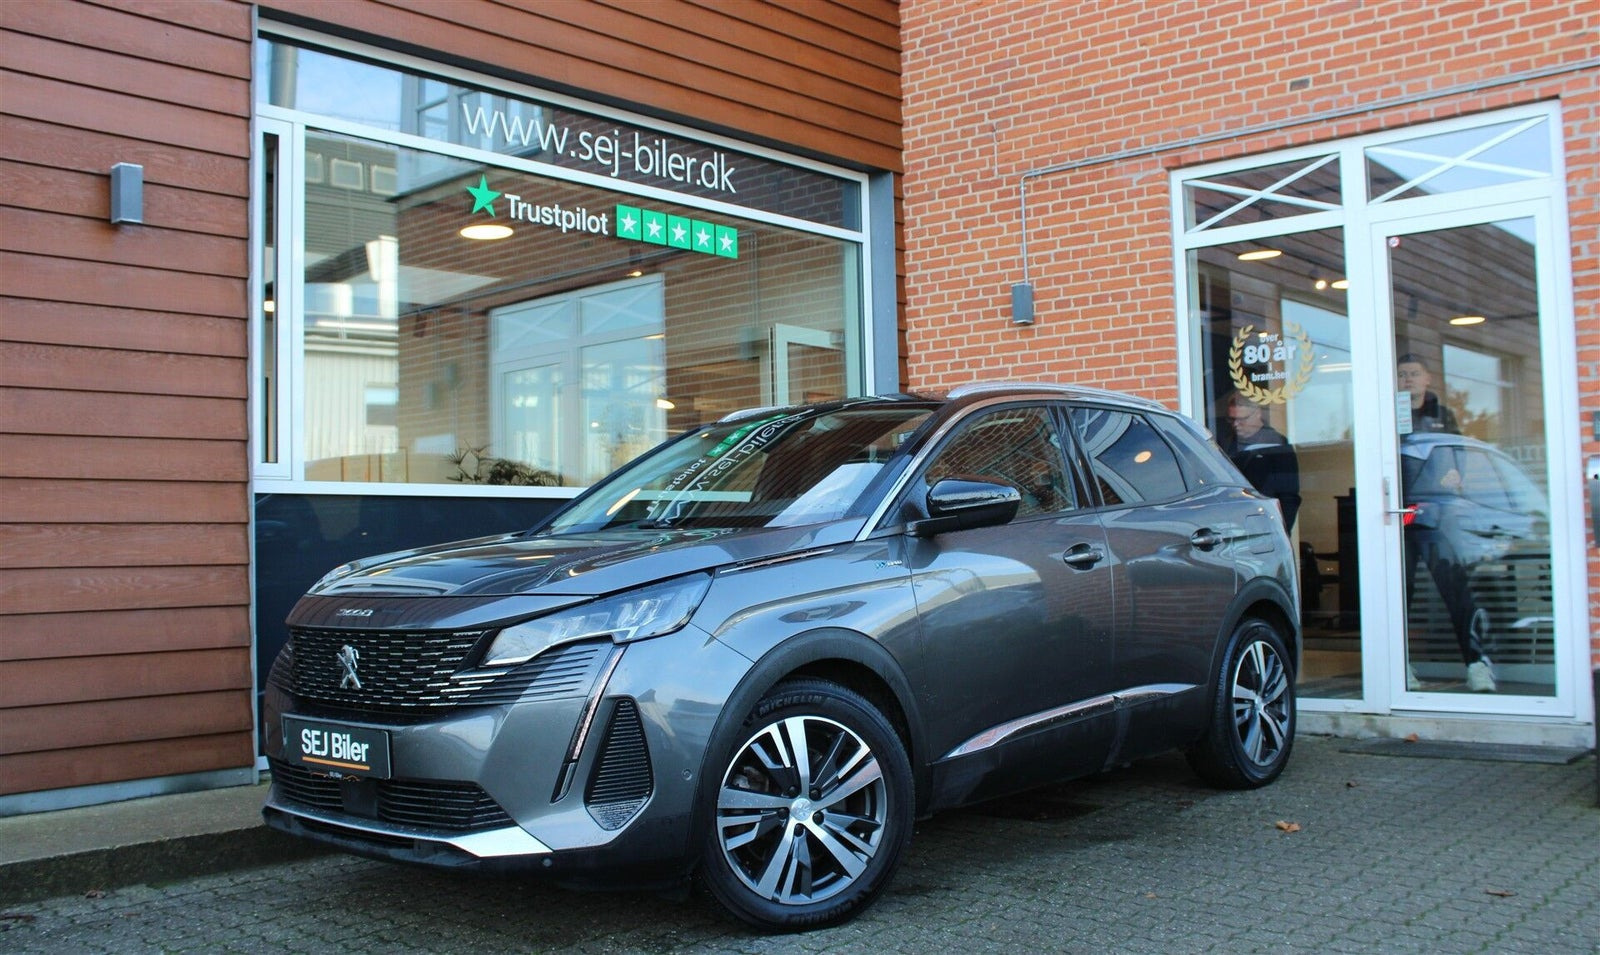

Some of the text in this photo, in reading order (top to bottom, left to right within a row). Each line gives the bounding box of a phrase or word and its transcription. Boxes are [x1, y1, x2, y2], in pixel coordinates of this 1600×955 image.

[462, 102, 737, 194] www.sej-biler.dk
[504, 193, 609, 236] Trustpilot
[1243, 340, 1297, 365] 80 år
[301, 728, 370, 763] SEJ Biler
